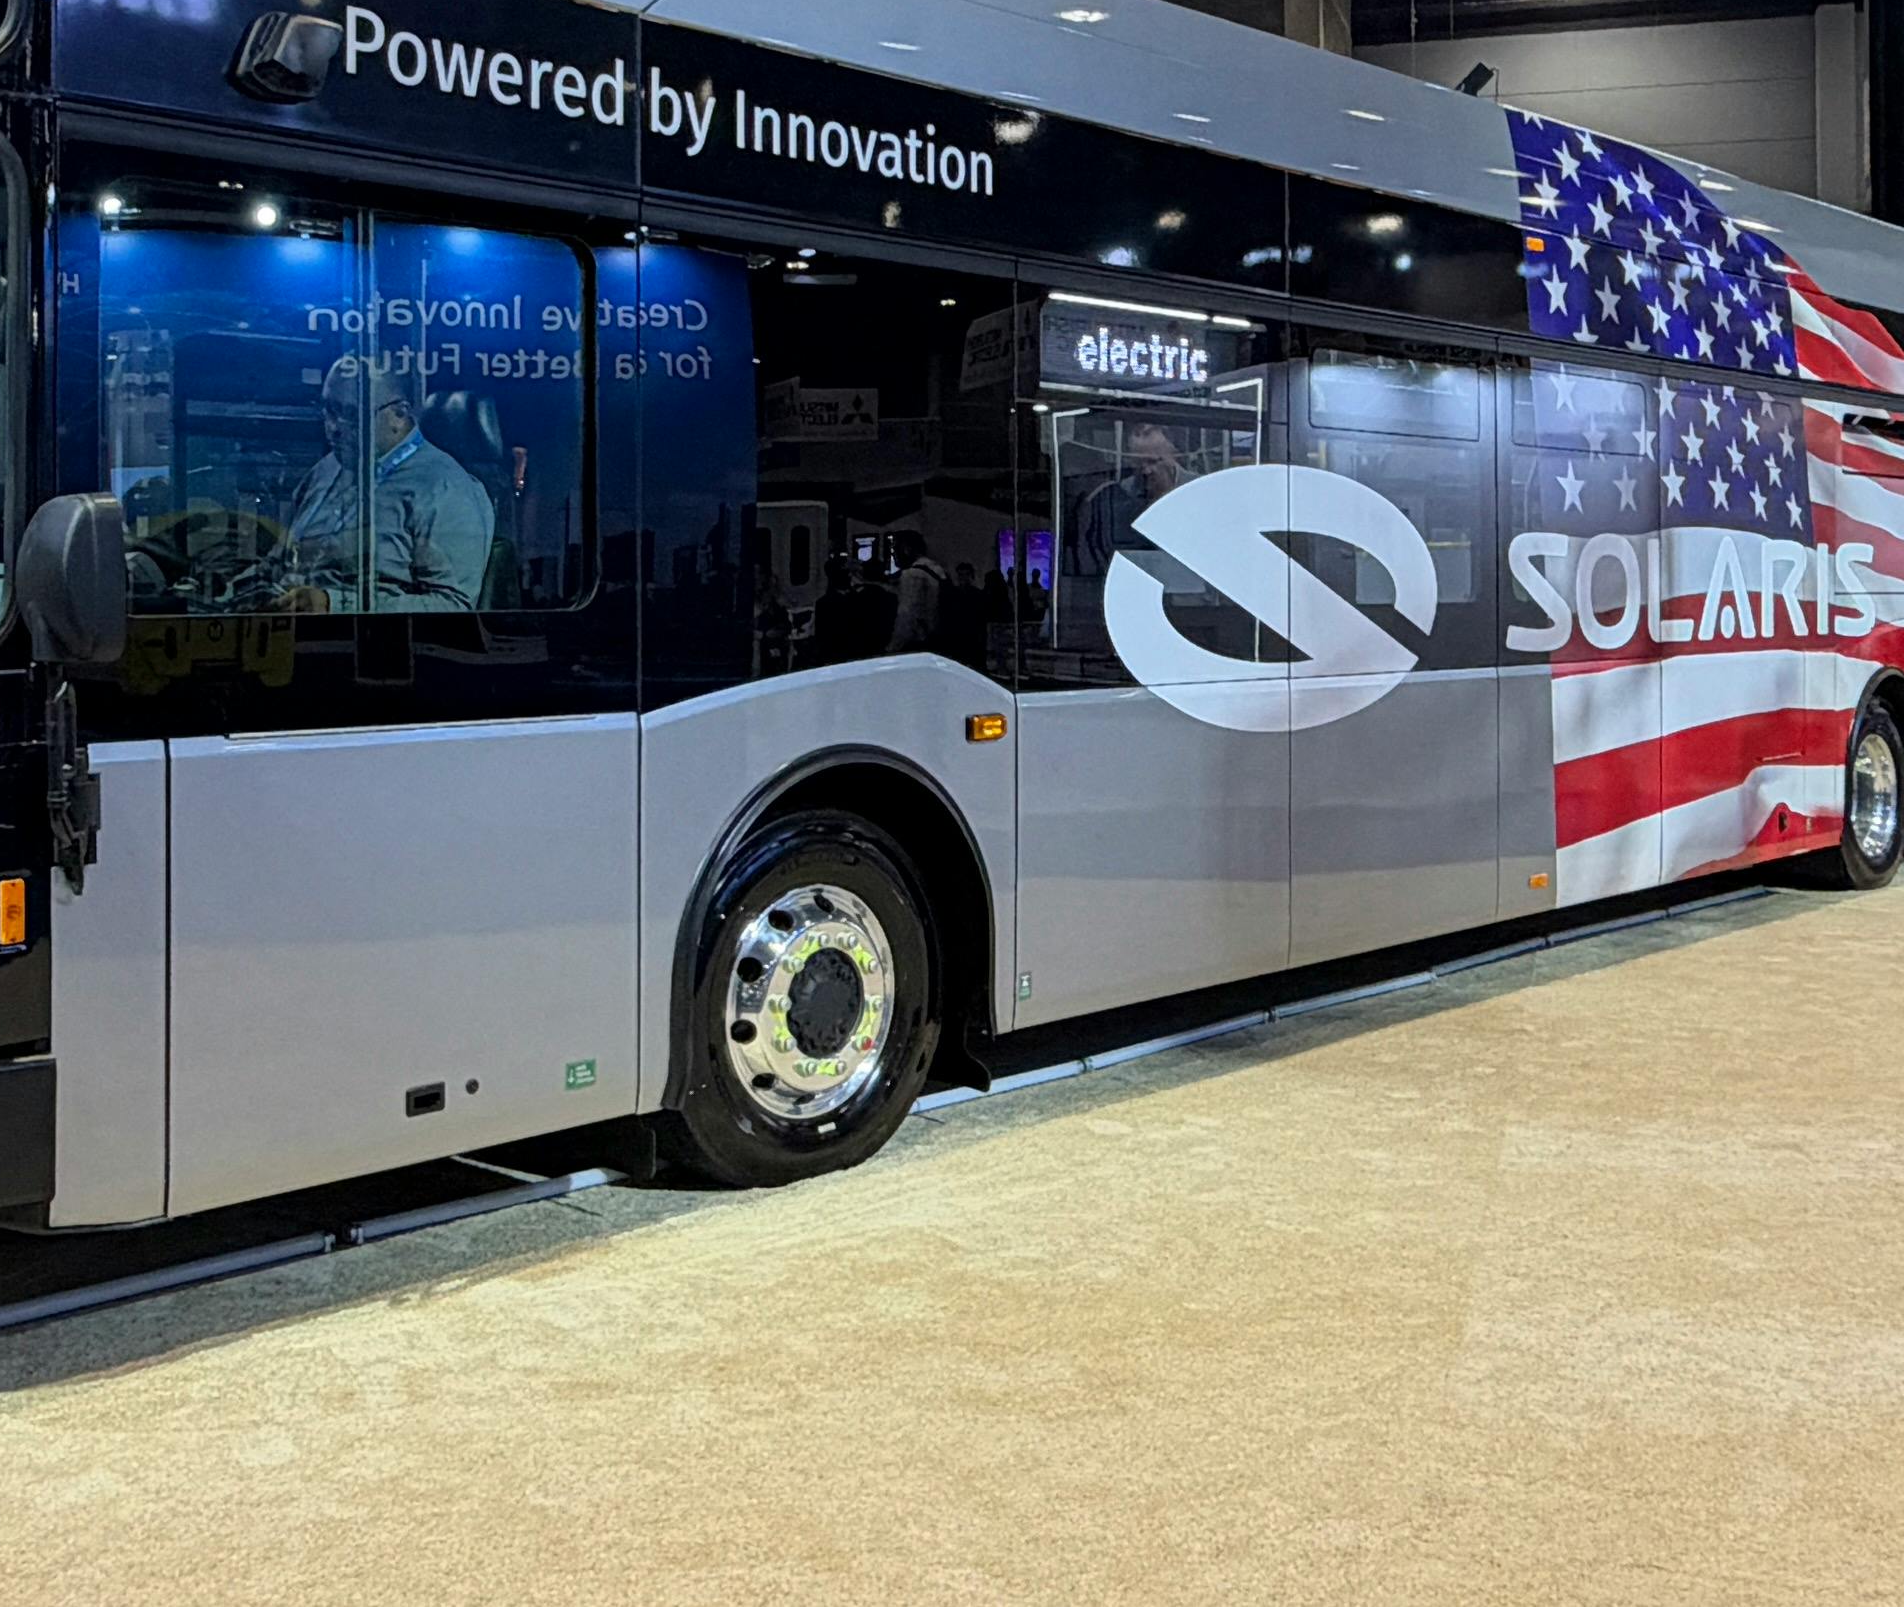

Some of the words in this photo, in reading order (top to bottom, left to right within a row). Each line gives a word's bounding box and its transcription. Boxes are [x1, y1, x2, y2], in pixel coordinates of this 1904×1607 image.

[343, 5, 626, 128] Powered
[649, 66, 716, 158] by
[733, 87, 996, 197] Innovation
[1074, 326, 1209, 382] electric
[1505, 531, 1876, 652] SOLARIS
